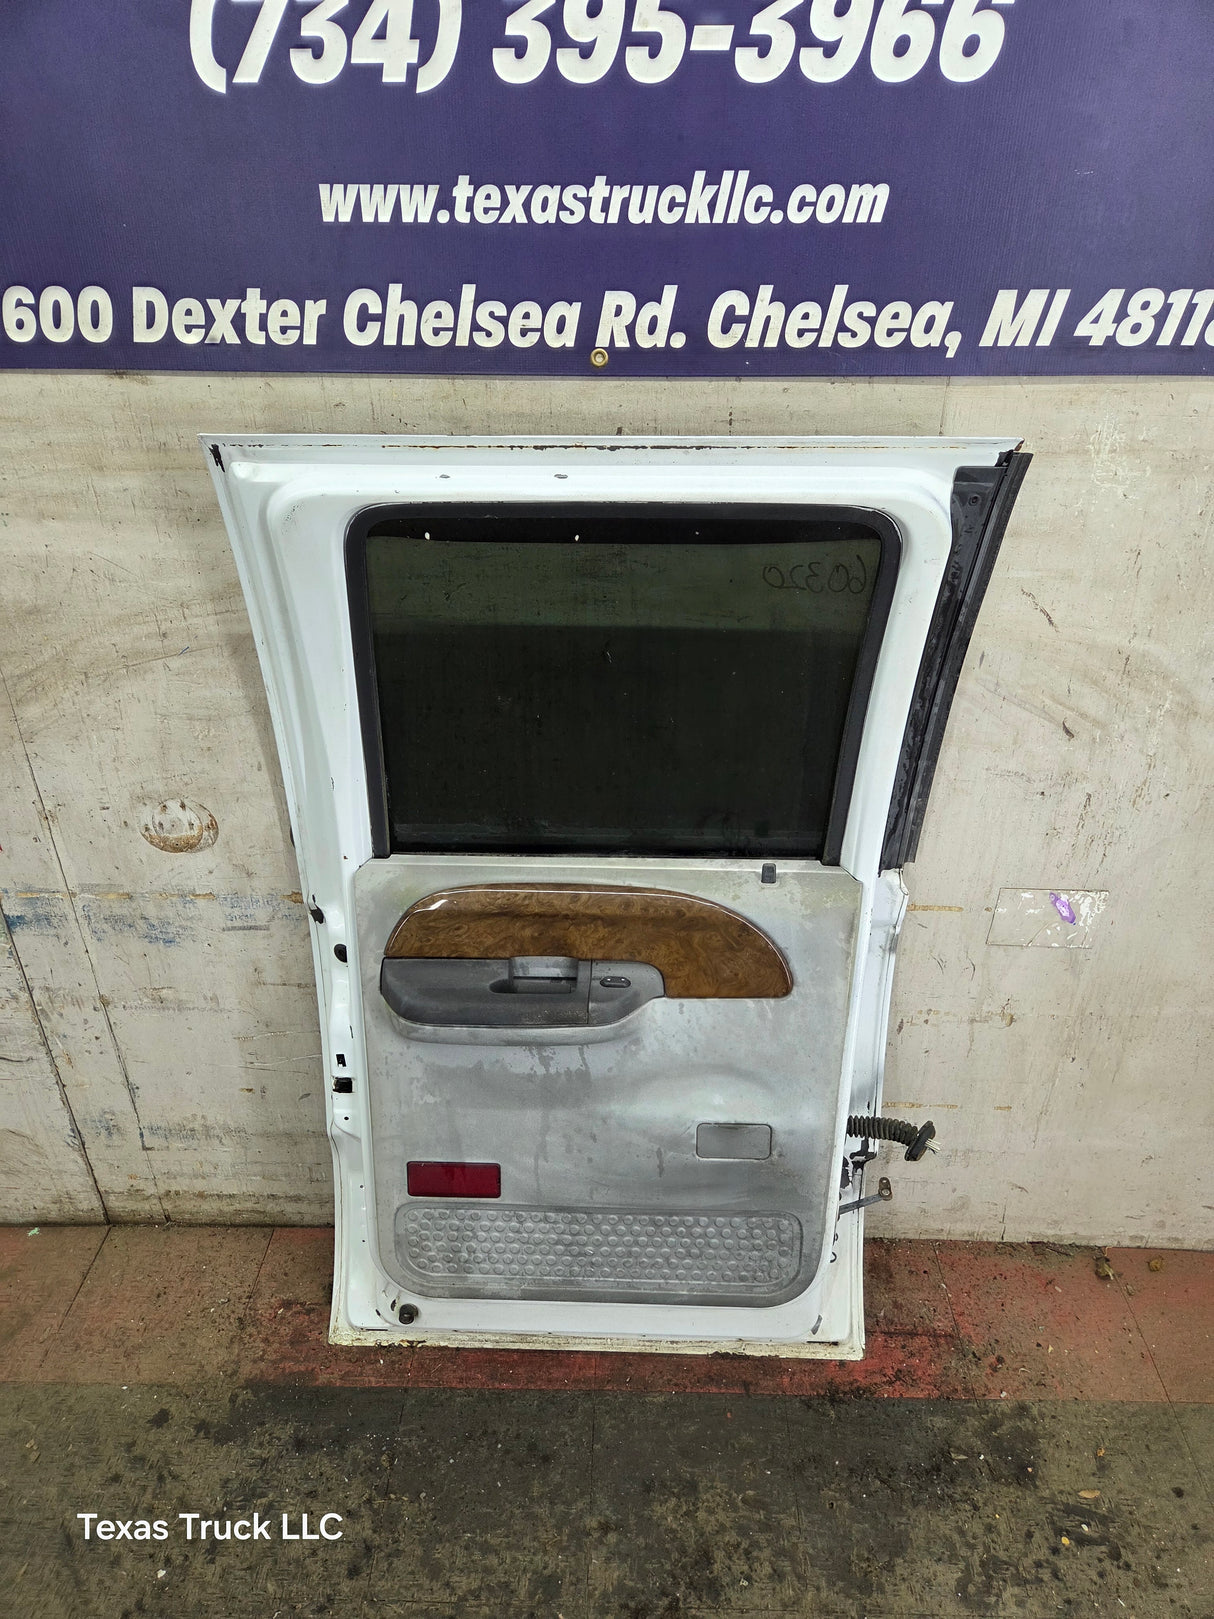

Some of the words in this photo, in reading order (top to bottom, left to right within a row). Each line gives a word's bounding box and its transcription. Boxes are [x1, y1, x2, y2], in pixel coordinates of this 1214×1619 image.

[190, 0, 463, 94] (734)
[492, 0, 1016, 85] 395-3966
[318, 170, 890, 225] www.texastruckllc.com
[2, 285, 114, 343] 600
[132, 286, 327, 346] Dexter
[343, 283, 582, 348] Chelsea
[593, 284, 687, 349] Rd.
[707, 284, 963, 359] Chelsea,
[978, 288, 1072, 347] MI
[1073, 287, 1214, 347] 4811
